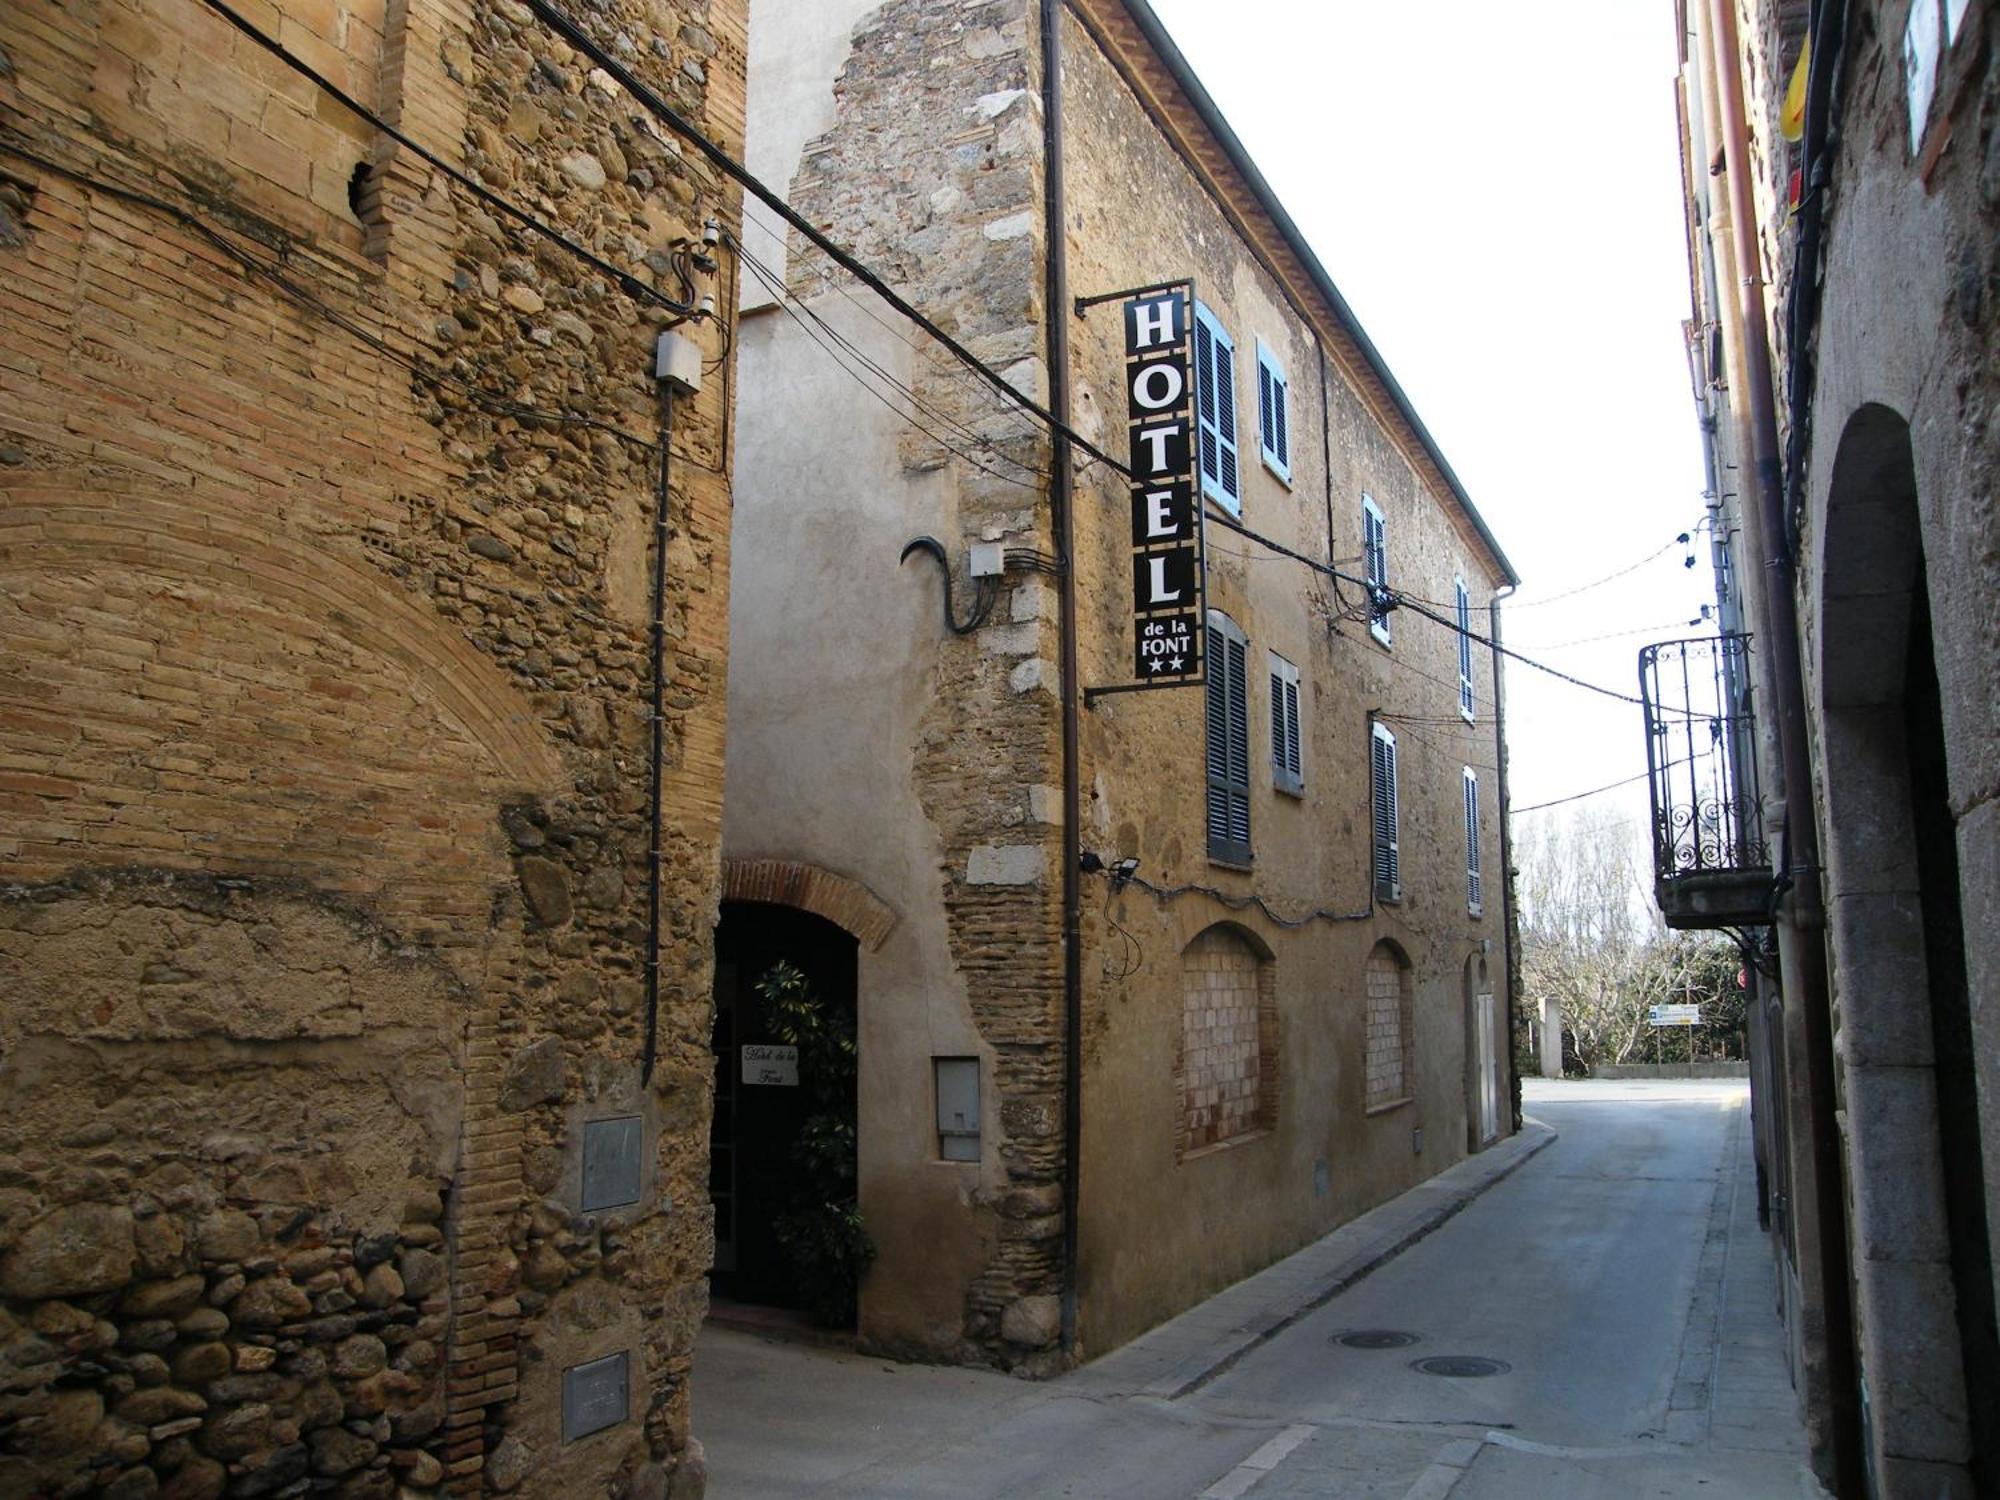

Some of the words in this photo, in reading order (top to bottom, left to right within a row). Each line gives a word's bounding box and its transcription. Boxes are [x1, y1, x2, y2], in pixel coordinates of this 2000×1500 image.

[1132, 299, 1182, 604] HOTEL
[1144, 622, 1164, 636] de
[1171, 619, 1187, 634] la
[1142, 635, 1190, 657] FONT
